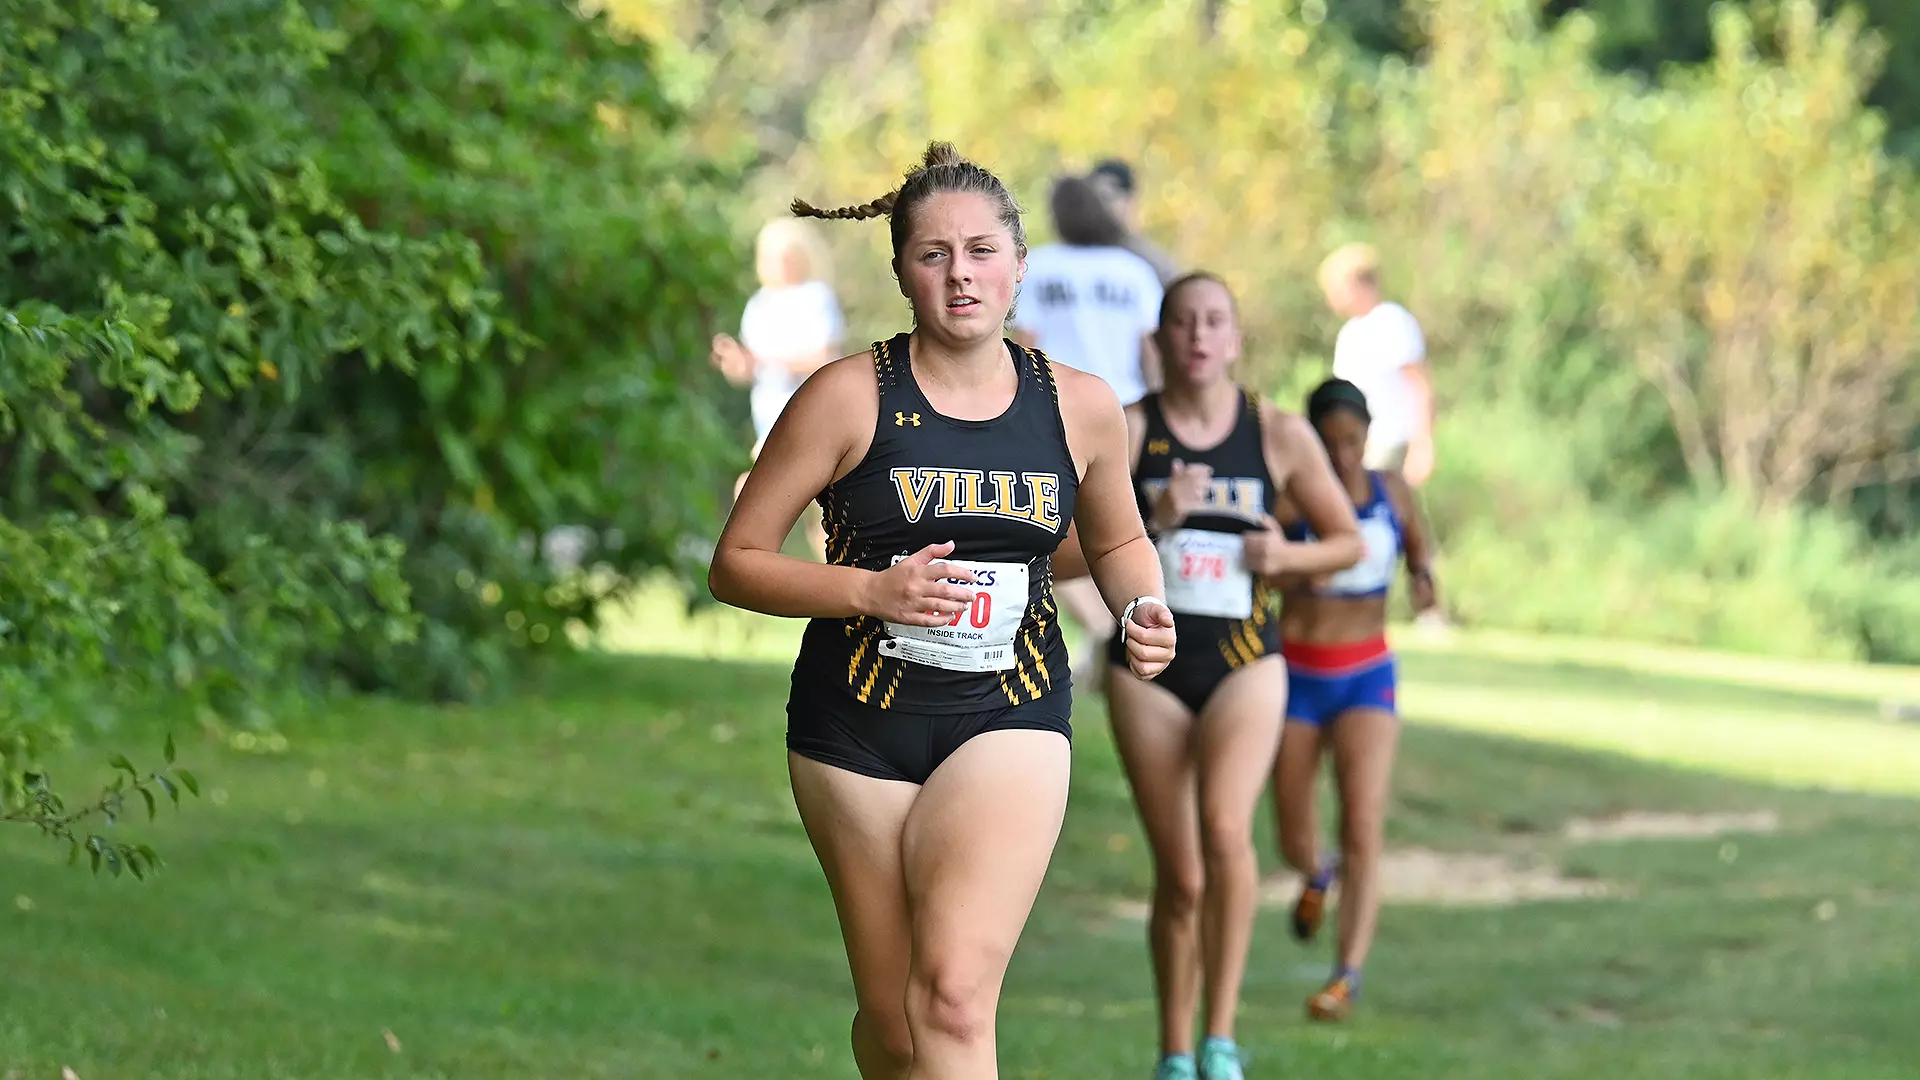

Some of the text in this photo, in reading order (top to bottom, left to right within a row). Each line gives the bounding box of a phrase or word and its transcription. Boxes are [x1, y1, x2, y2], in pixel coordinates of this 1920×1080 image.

[890, 467, 1061, 534] VILLE
[927, 628, 955, 638] INSIDE
[956, 631, 983, 640] TRACK
